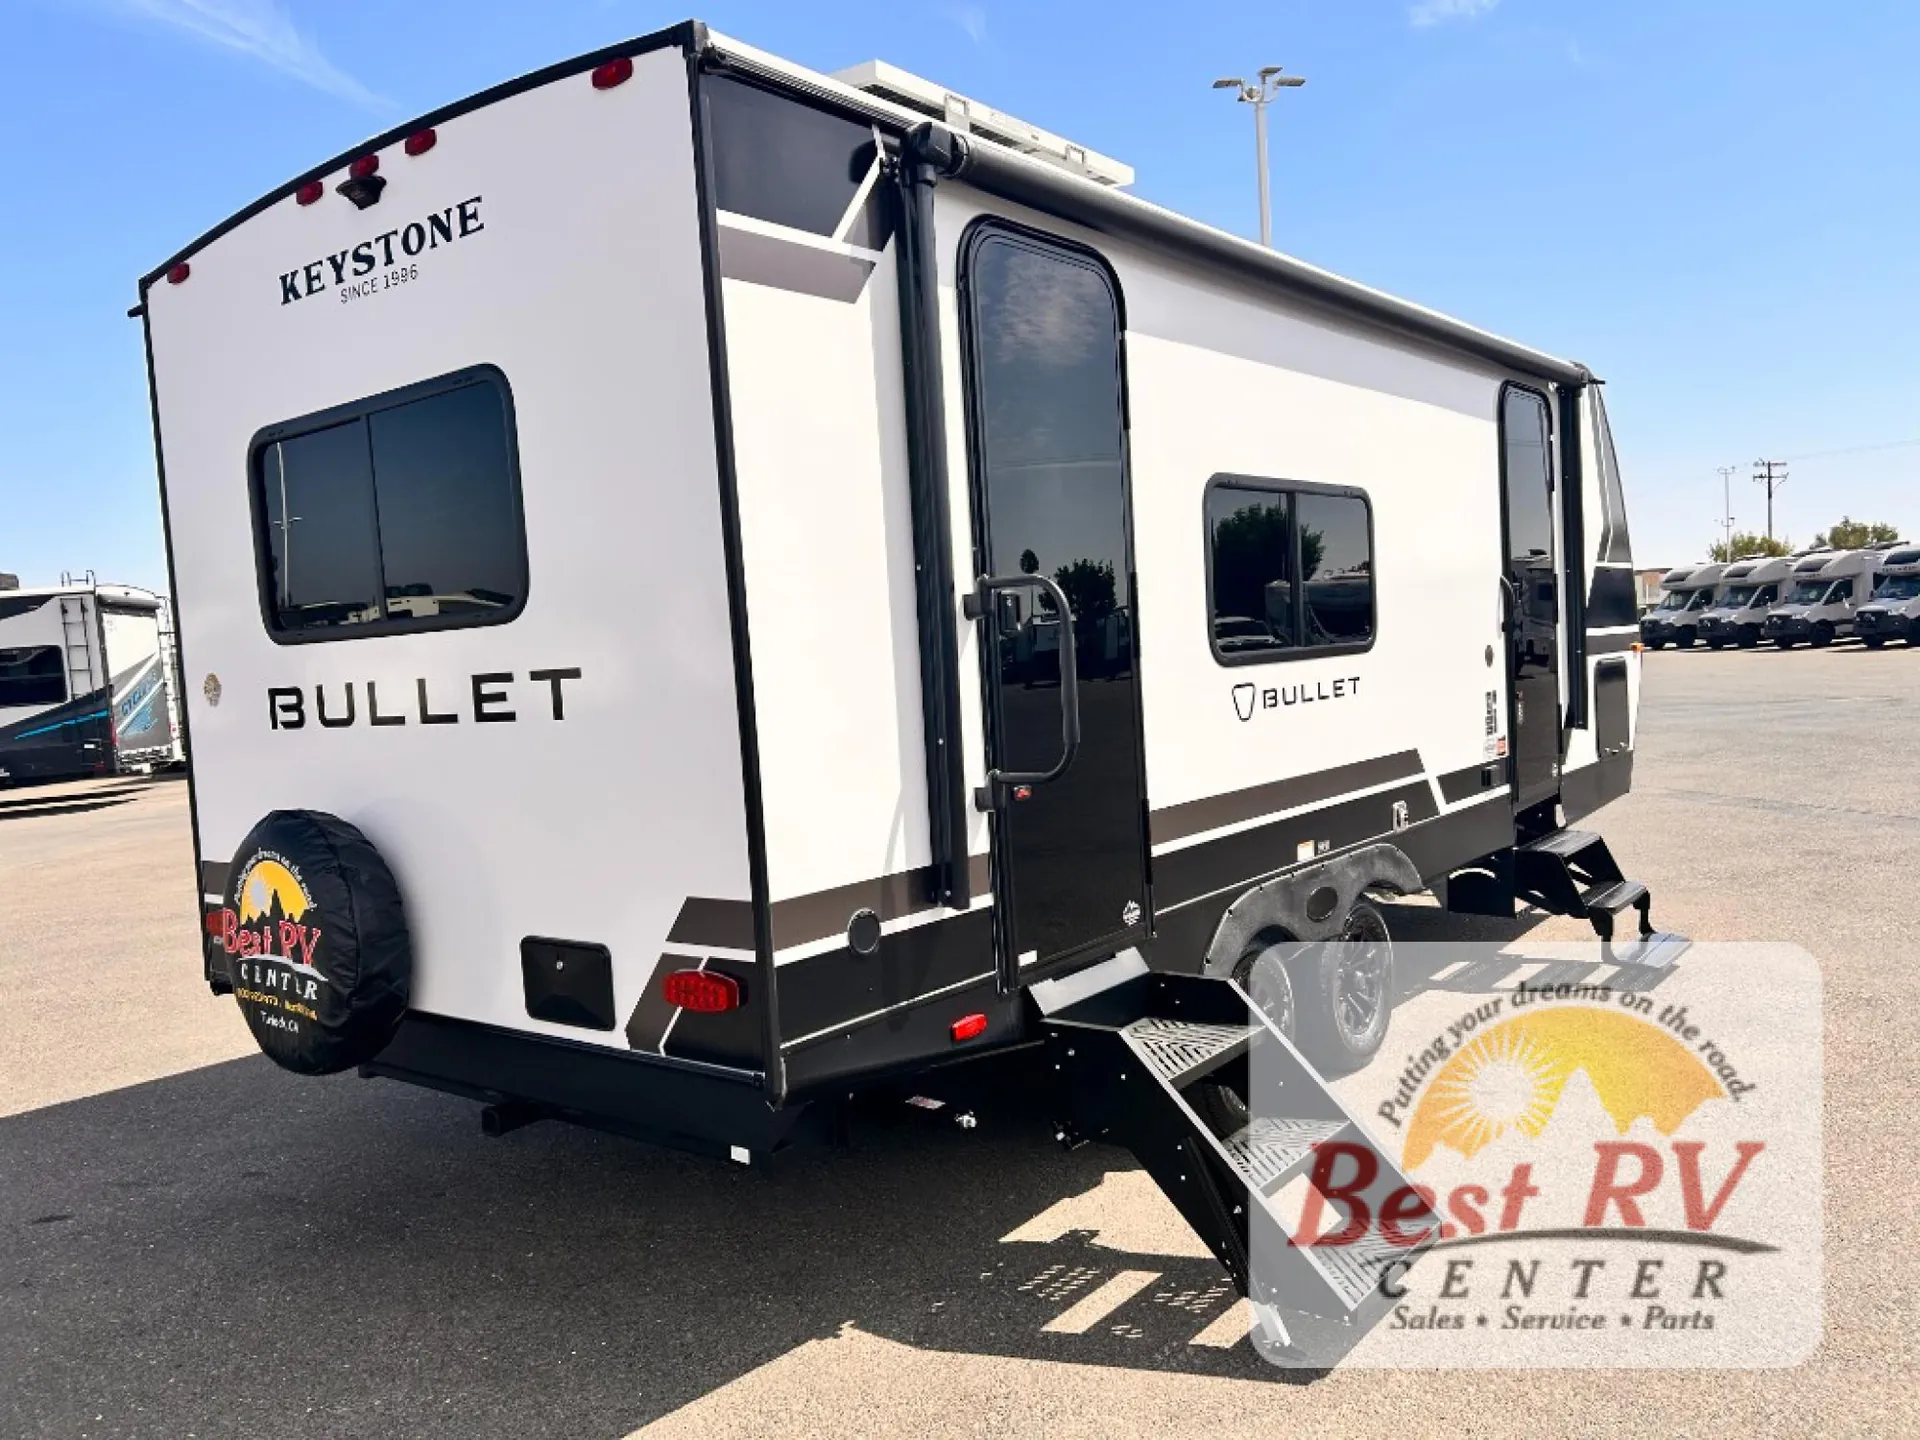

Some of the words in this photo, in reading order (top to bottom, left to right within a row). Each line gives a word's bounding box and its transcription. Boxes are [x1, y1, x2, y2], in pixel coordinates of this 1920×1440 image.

[279, 195, 485, 305] KEYSTONE
[340, 277, 378, 304] SINCE
[267, 667, 582, 730] BULLET
[1262, 676, 1360, 709] BULLET
[223, 907, 273, 956] Best
[278, 919, 322, 966] RV
